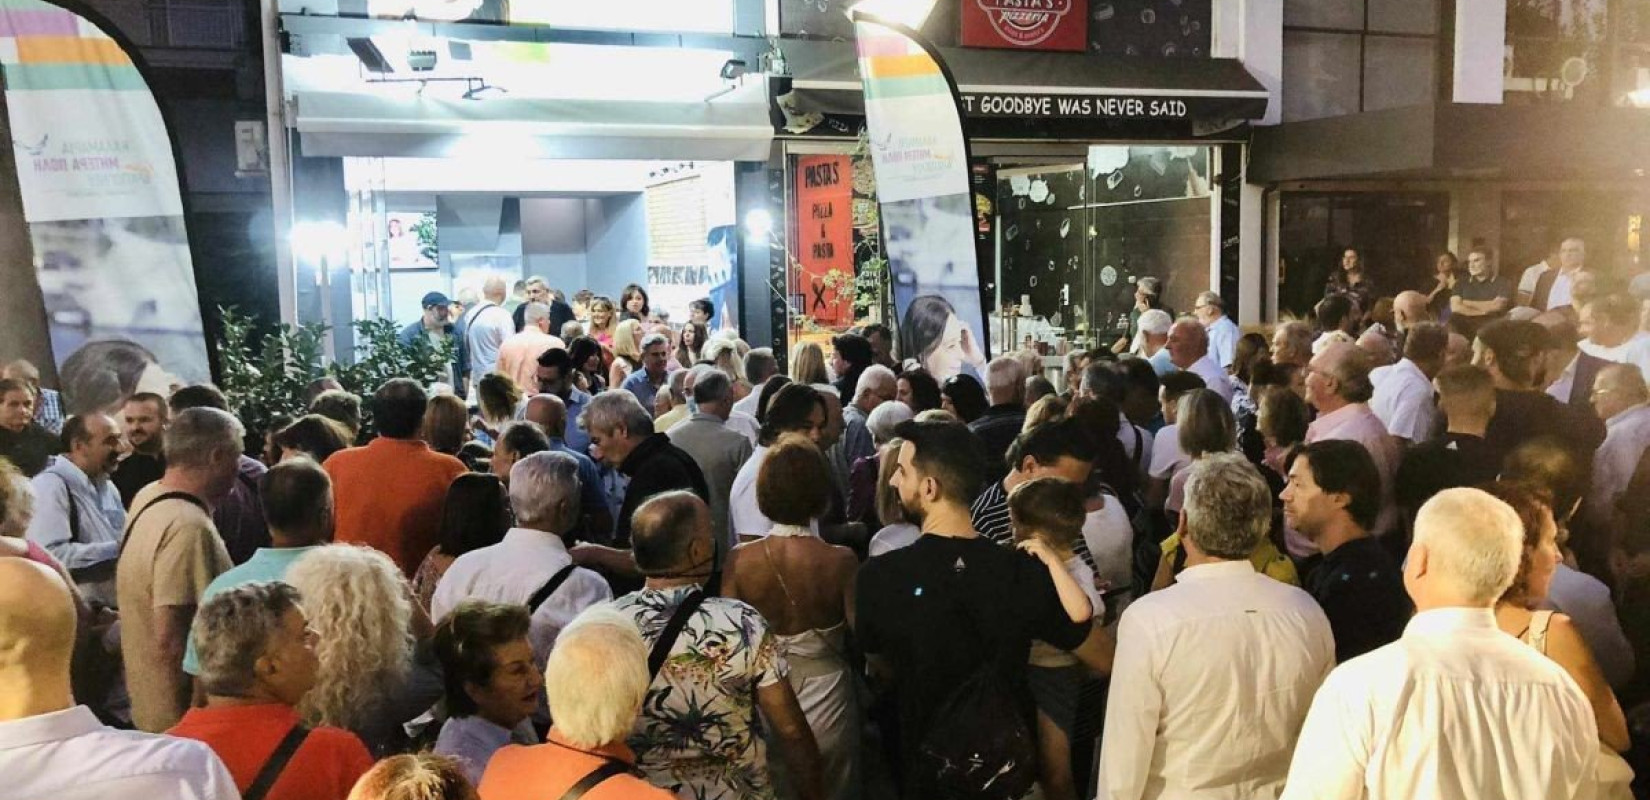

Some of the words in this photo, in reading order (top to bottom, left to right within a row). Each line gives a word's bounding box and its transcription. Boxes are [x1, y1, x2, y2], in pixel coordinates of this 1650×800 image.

[981, 96, 1051, 115] GOODBYE
[1058, 98, 1091, 115] WAS
[1096, 99, 1144, 116] NEVER
[1149, 101, 1187, 117] SAID
